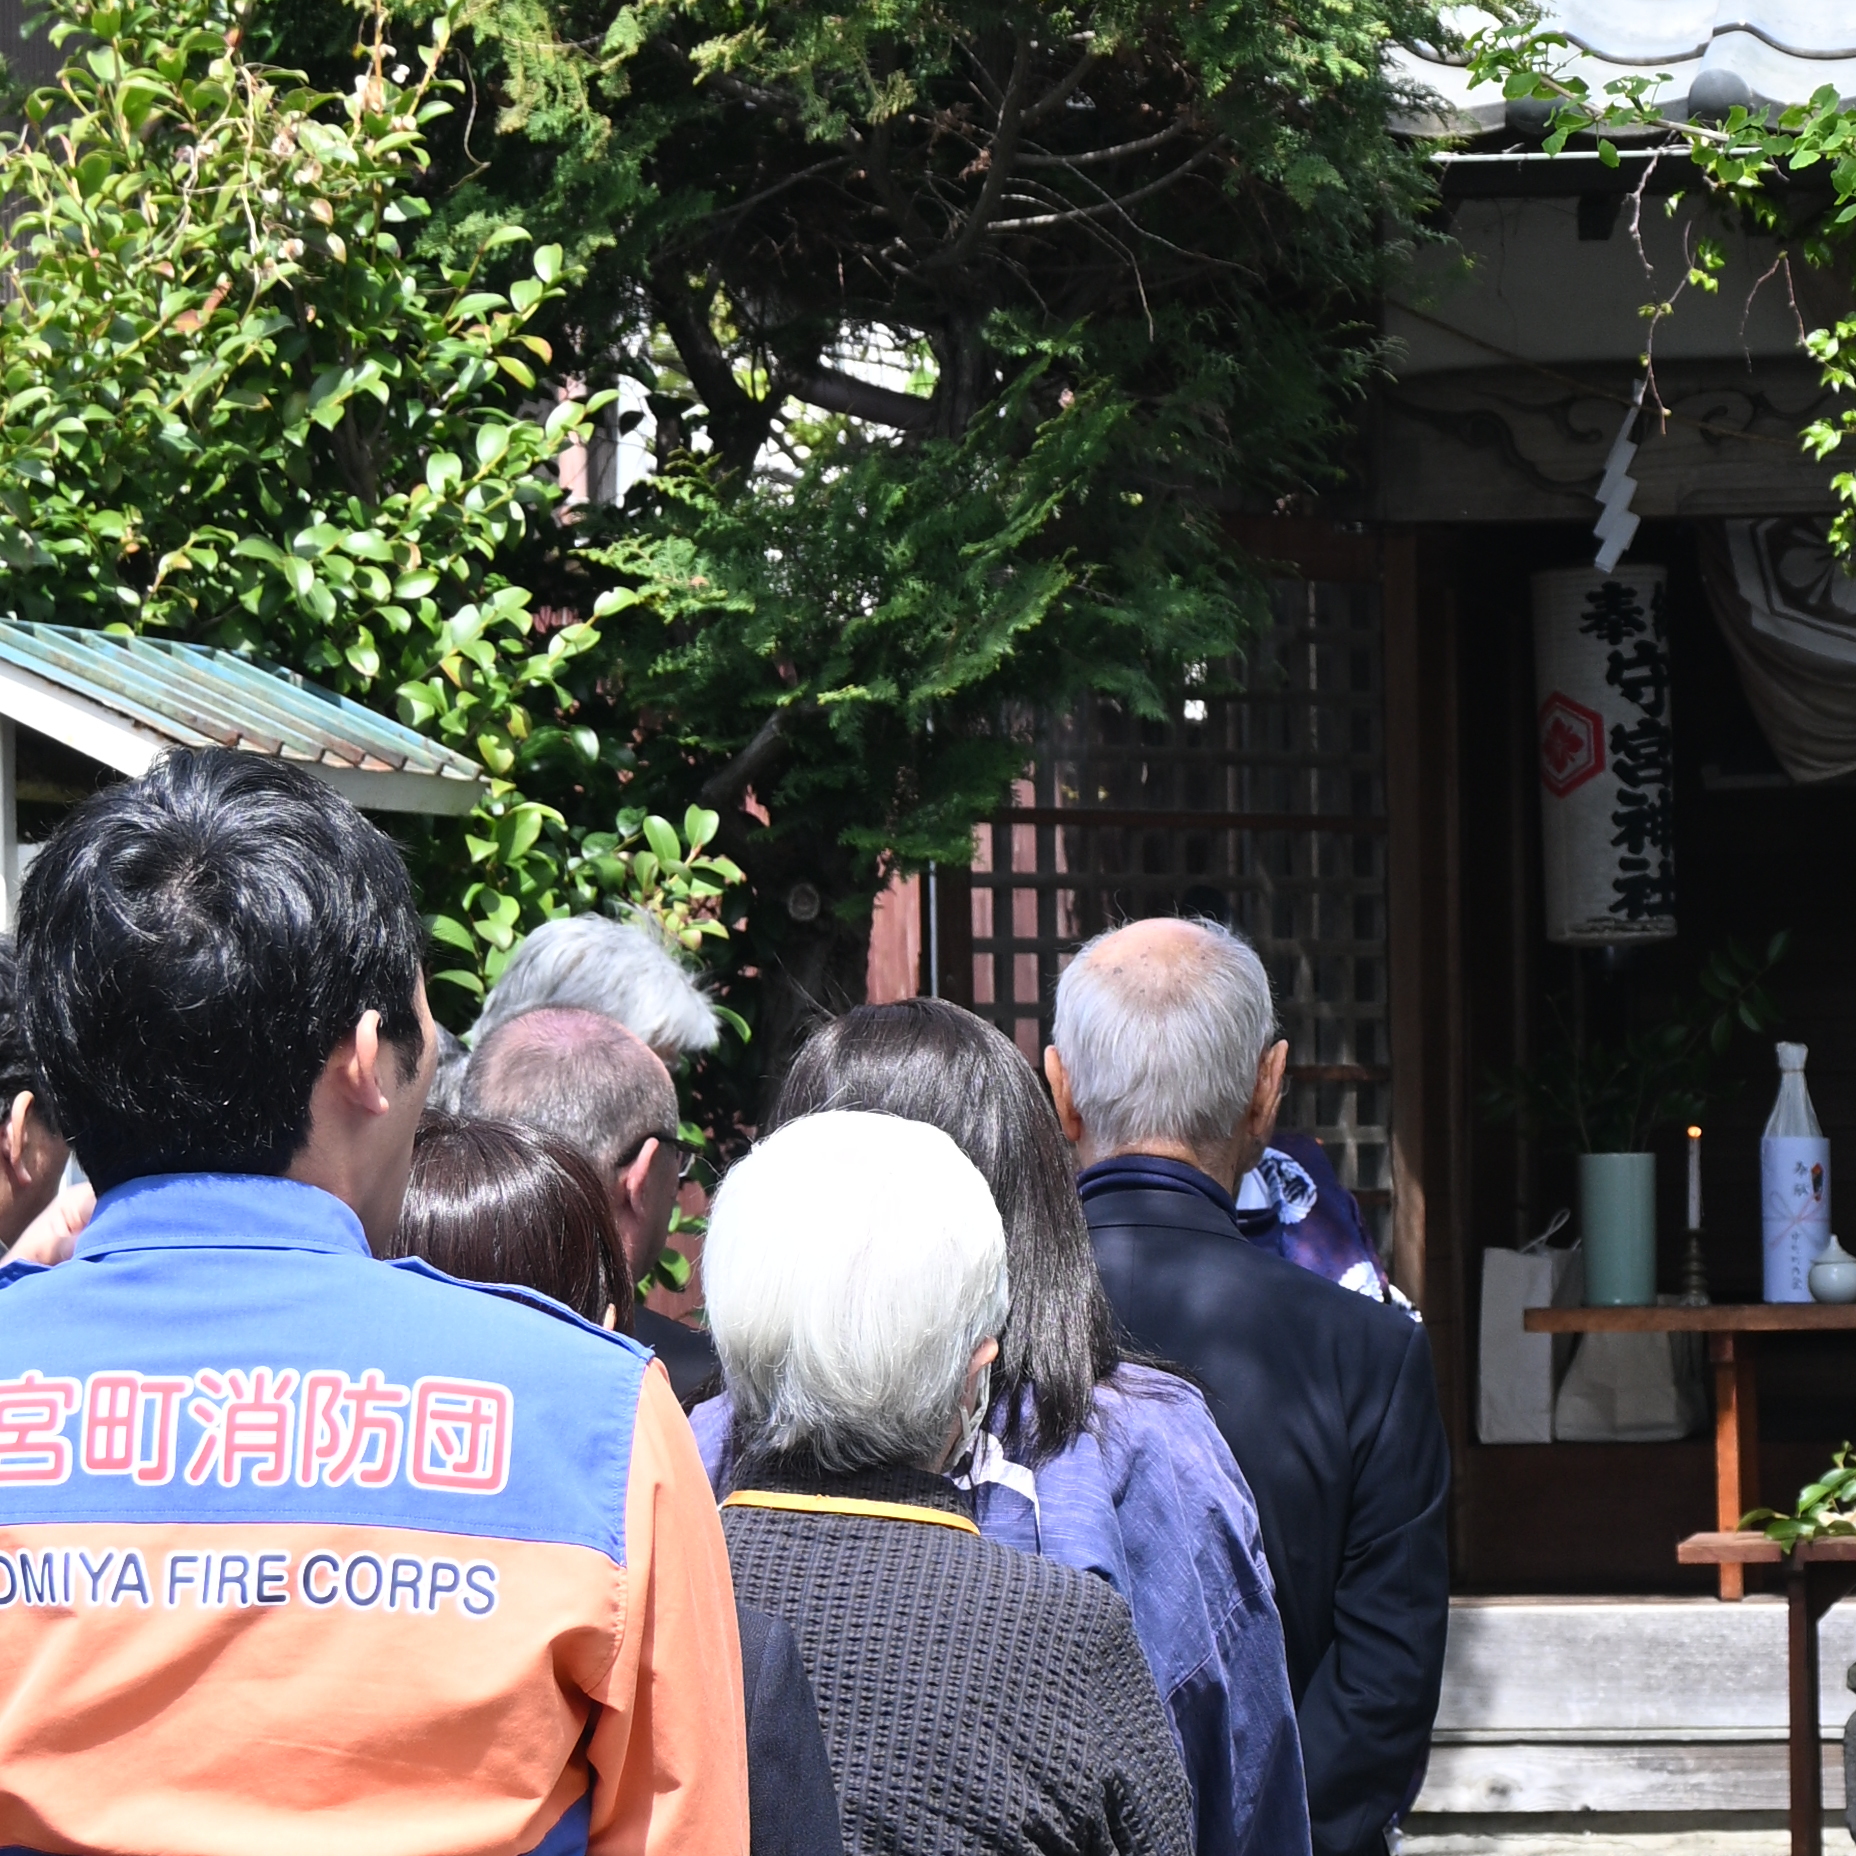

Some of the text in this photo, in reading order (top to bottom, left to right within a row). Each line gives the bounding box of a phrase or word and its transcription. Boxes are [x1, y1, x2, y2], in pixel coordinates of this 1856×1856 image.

[0, 1368, 513, 1494] 宮町消防団
[167, 1552, 291, 1605] FIRE
[301, 1553, 498, 1616] CORPS
